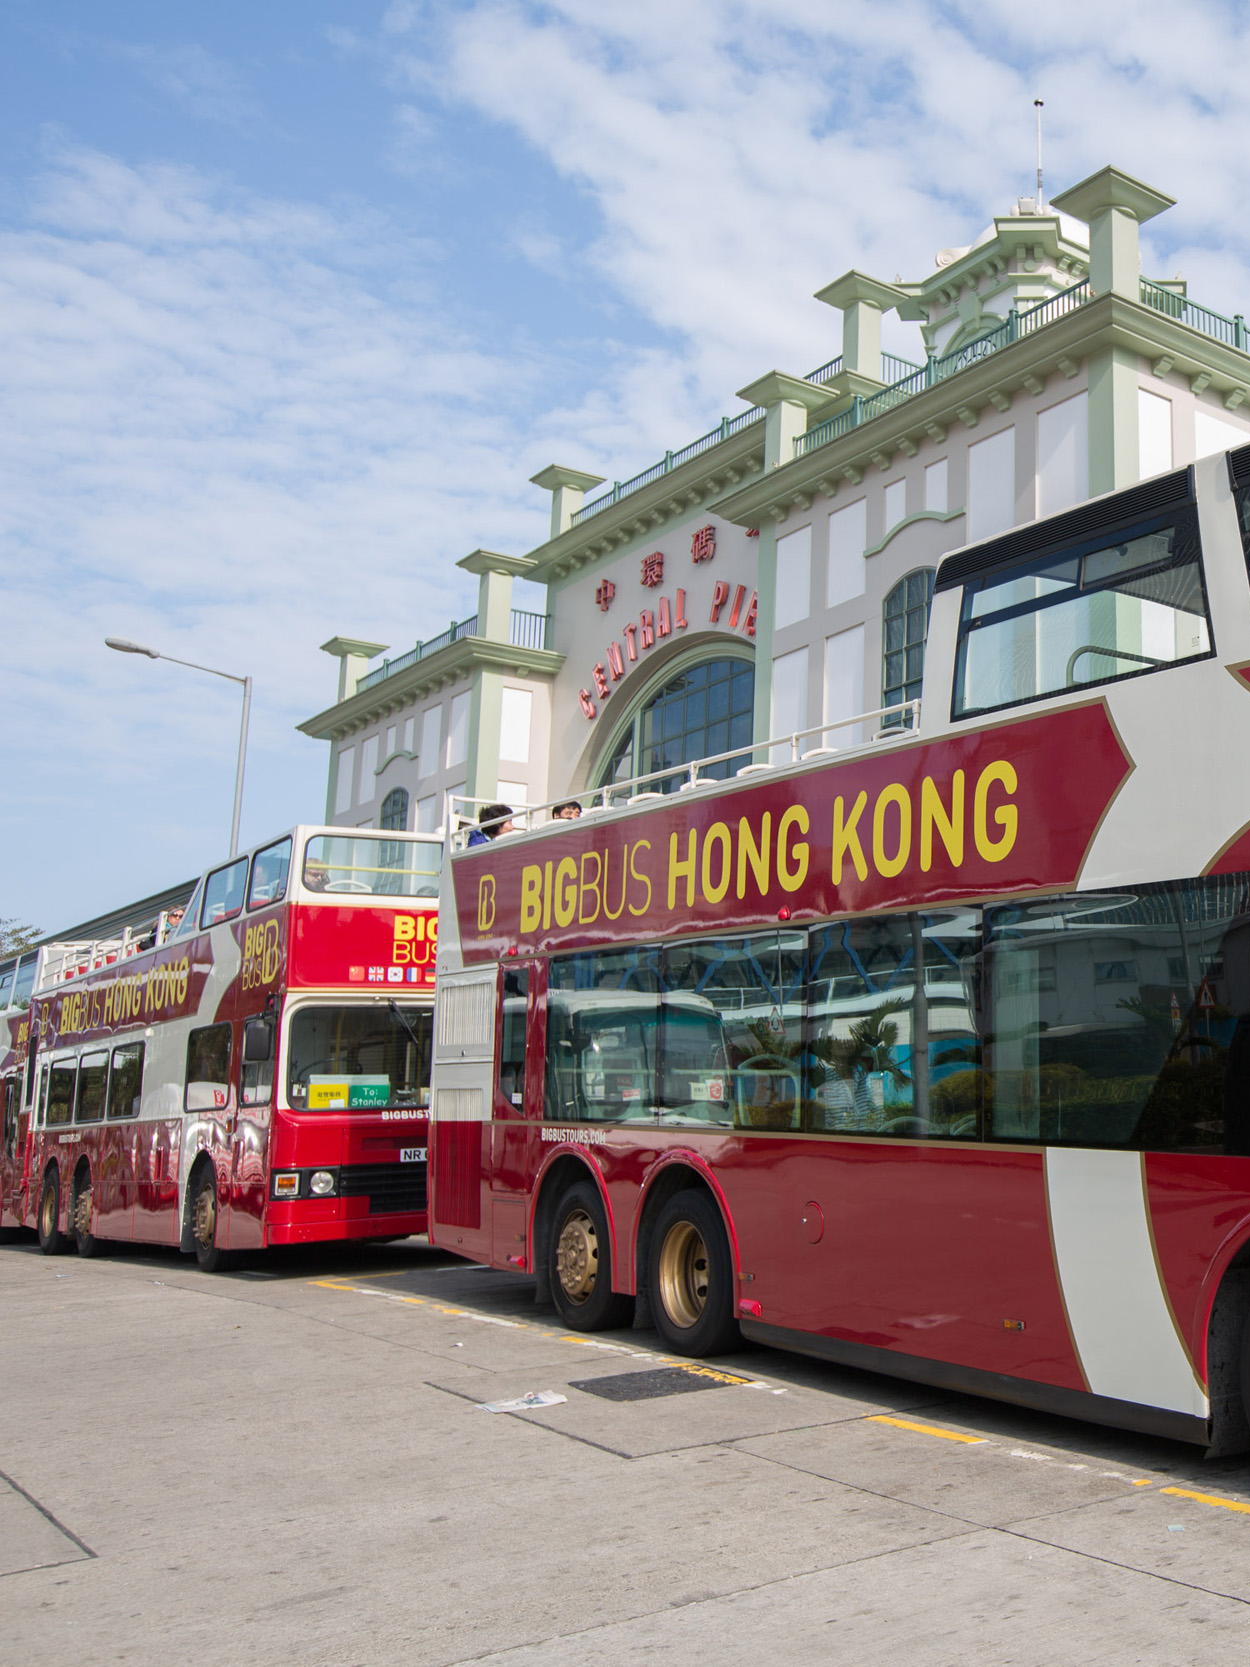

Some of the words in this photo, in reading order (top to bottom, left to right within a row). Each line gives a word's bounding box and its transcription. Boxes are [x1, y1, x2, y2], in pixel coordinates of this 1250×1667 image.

[595, 524, 759, 612] 中環碼
[578, 588, 688, 720] CENTRAL
[667, 804, 810, 911] HONG
[831, 760, 1019, 887] KONG
[245, 923, 264, 959] BIG
[242, 953, 262, 991] BUS
[103, 972, 142, 1025] HONG
[145, 956, 189, 1013] KONG
[351, 1097, 388, 1107] Stanley
[363, 1087, 378, 1096] To:
[382, 1109, 431, 1120] BIGBUST
[403, 1149, 421, 1160] NR
[541, 1128, 606, 1145] BIGBUSTOURS.COM
